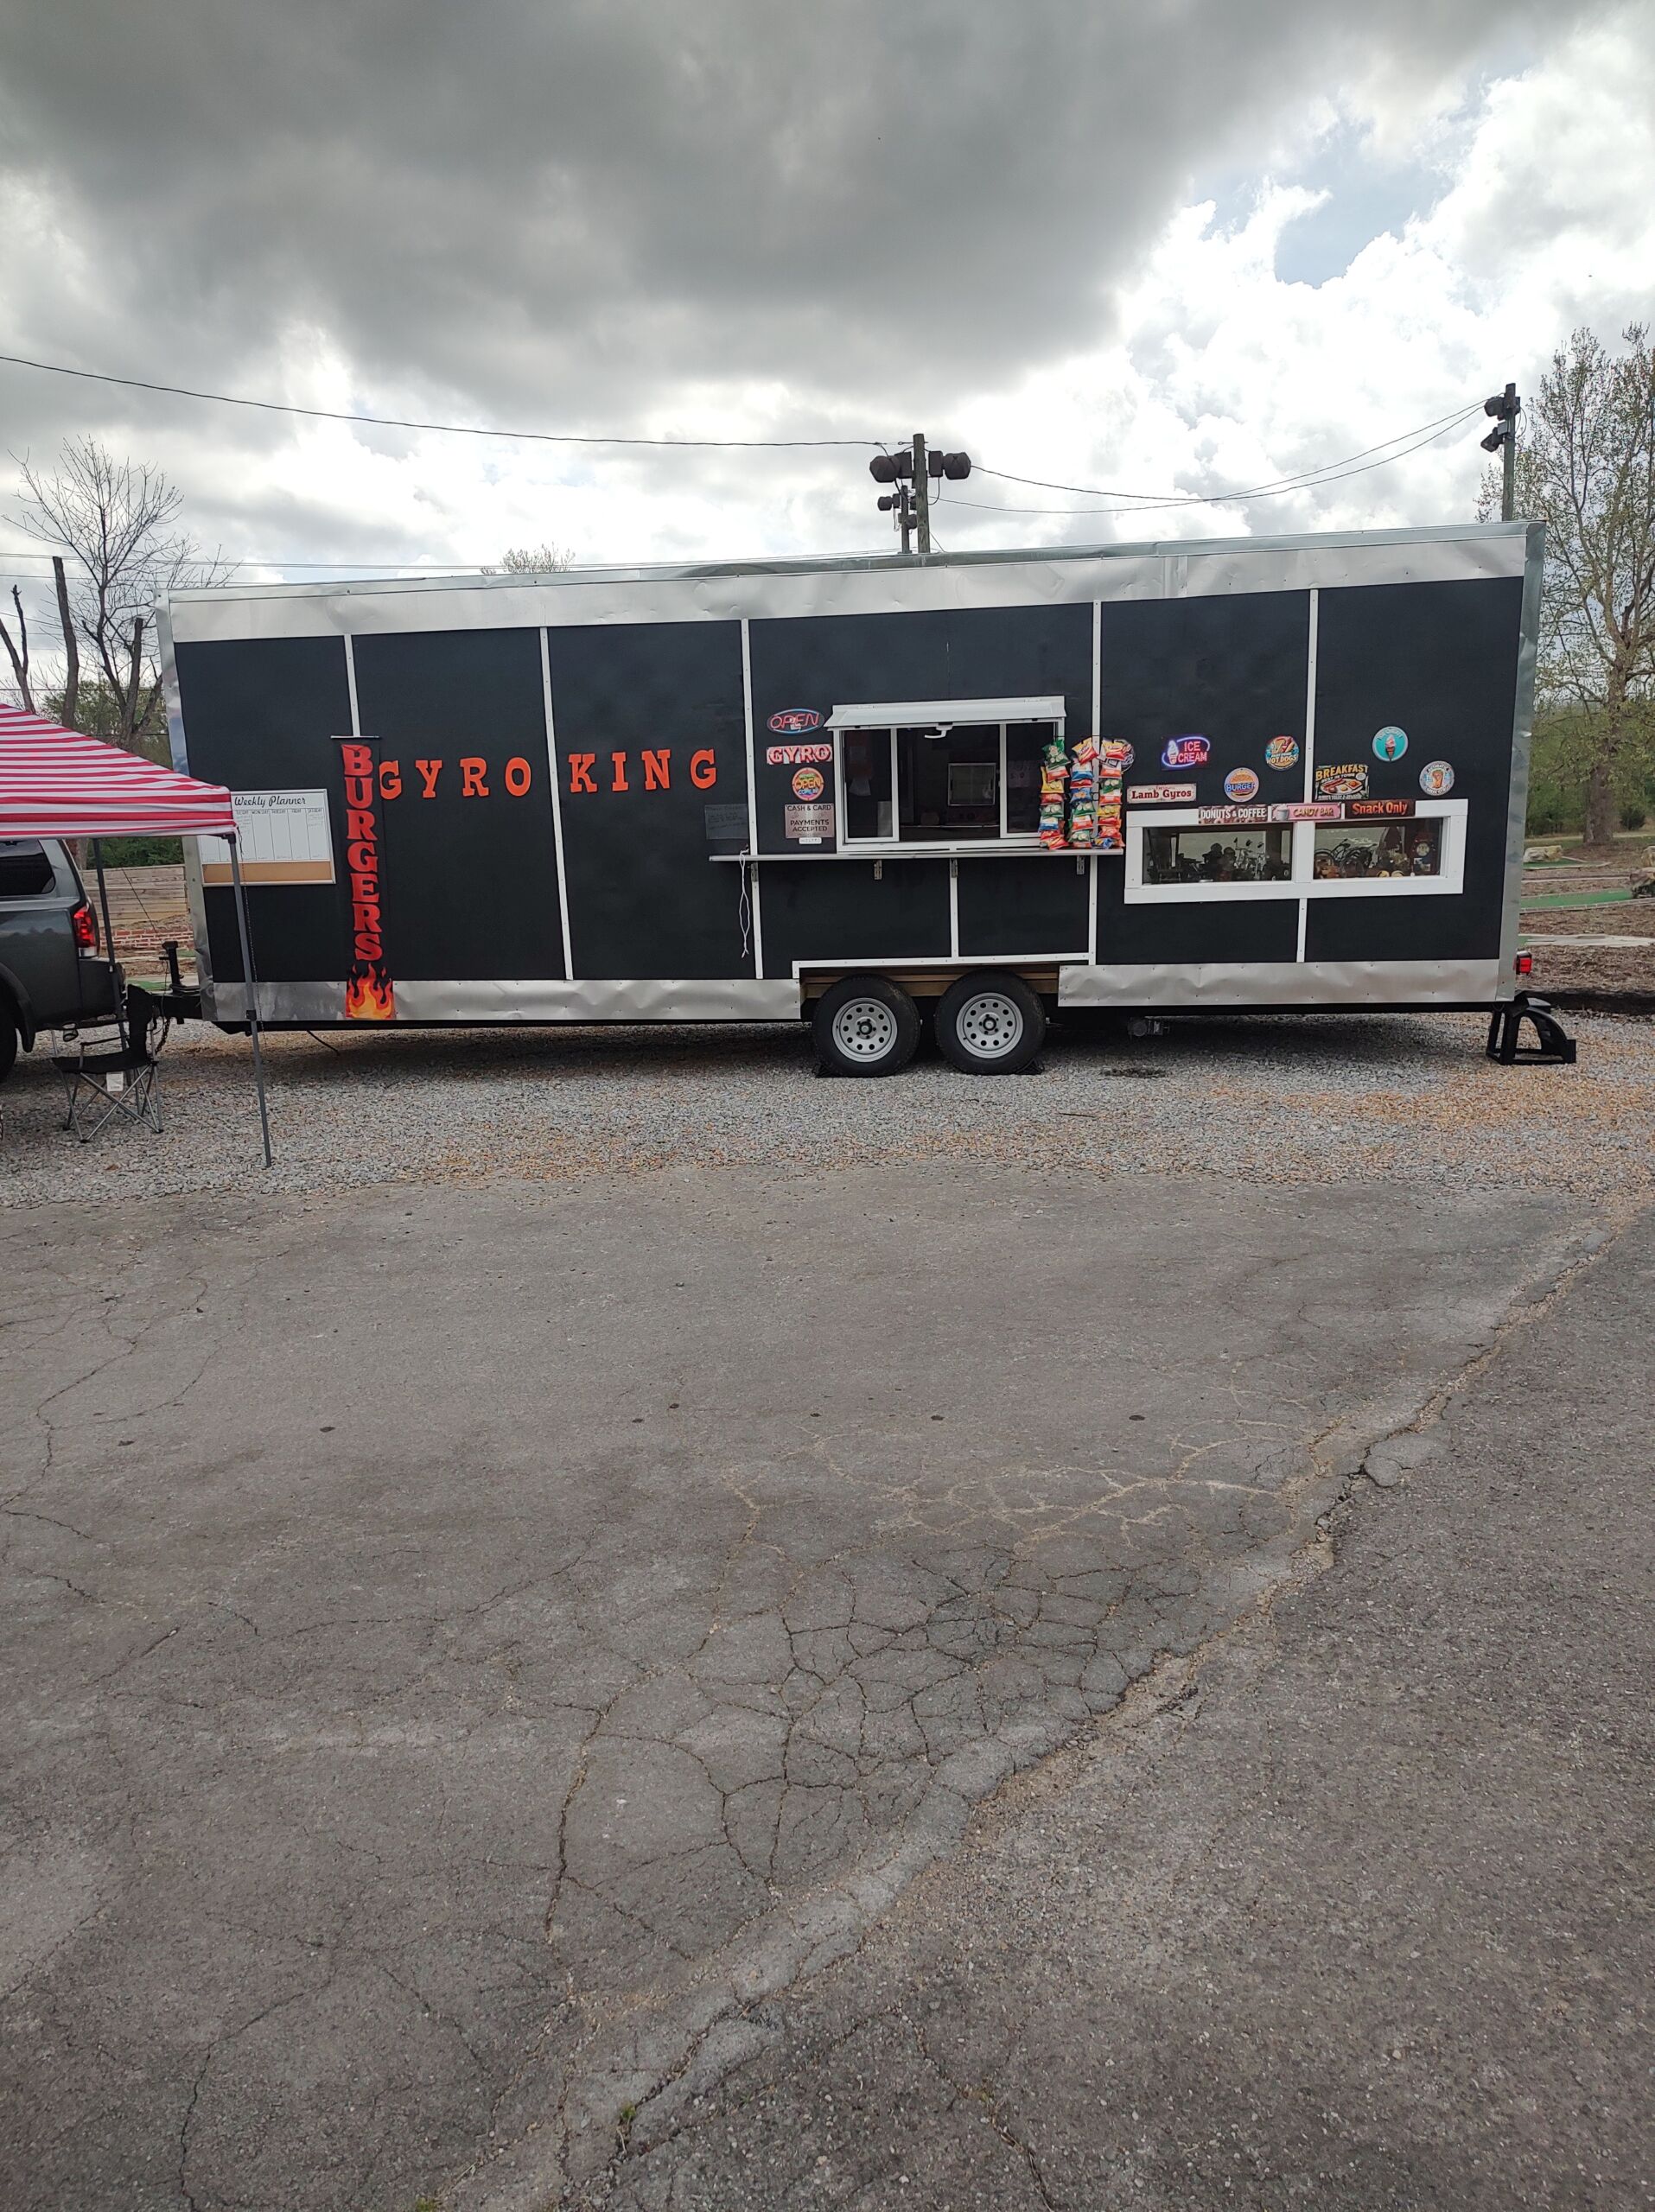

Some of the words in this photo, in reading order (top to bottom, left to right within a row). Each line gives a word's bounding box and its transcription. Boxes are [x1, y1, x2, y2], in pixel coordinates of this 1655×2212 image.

[770, 713, 819, 729] OPEN
[1184, 741, 1201, 752] ICE
[768, 746, 831, 764] GYRO
[1178, 751, 1207, 763] CREAM
[379, 756, 532, 800] GYRO
[568, 748, 717, 794] KING
[1315, 764, 1369, 781] BREAKFAST
[795, 778, 821, 790] OPEN
[1225, 783, 1256, 792] BURGER
[1131, 789, 1159, 799] Lamb
[1162, 789, 1192, 799] Gyros
[234, 796, 265, 808] Weekly
[269, 795, 306, 807] Planner
[1200, 809, 1231, 819] DONUTS
[1238, 808, 1266, 818] COFFEE
[1293, 807, 1318, 817] CANDY
[1320, 806, 1334, 817] BAR
[1352, 803, 1383, 815] Snack
[1385, 801, 1407, 815] Only
[342, 745, 383, 961] BURGERS
